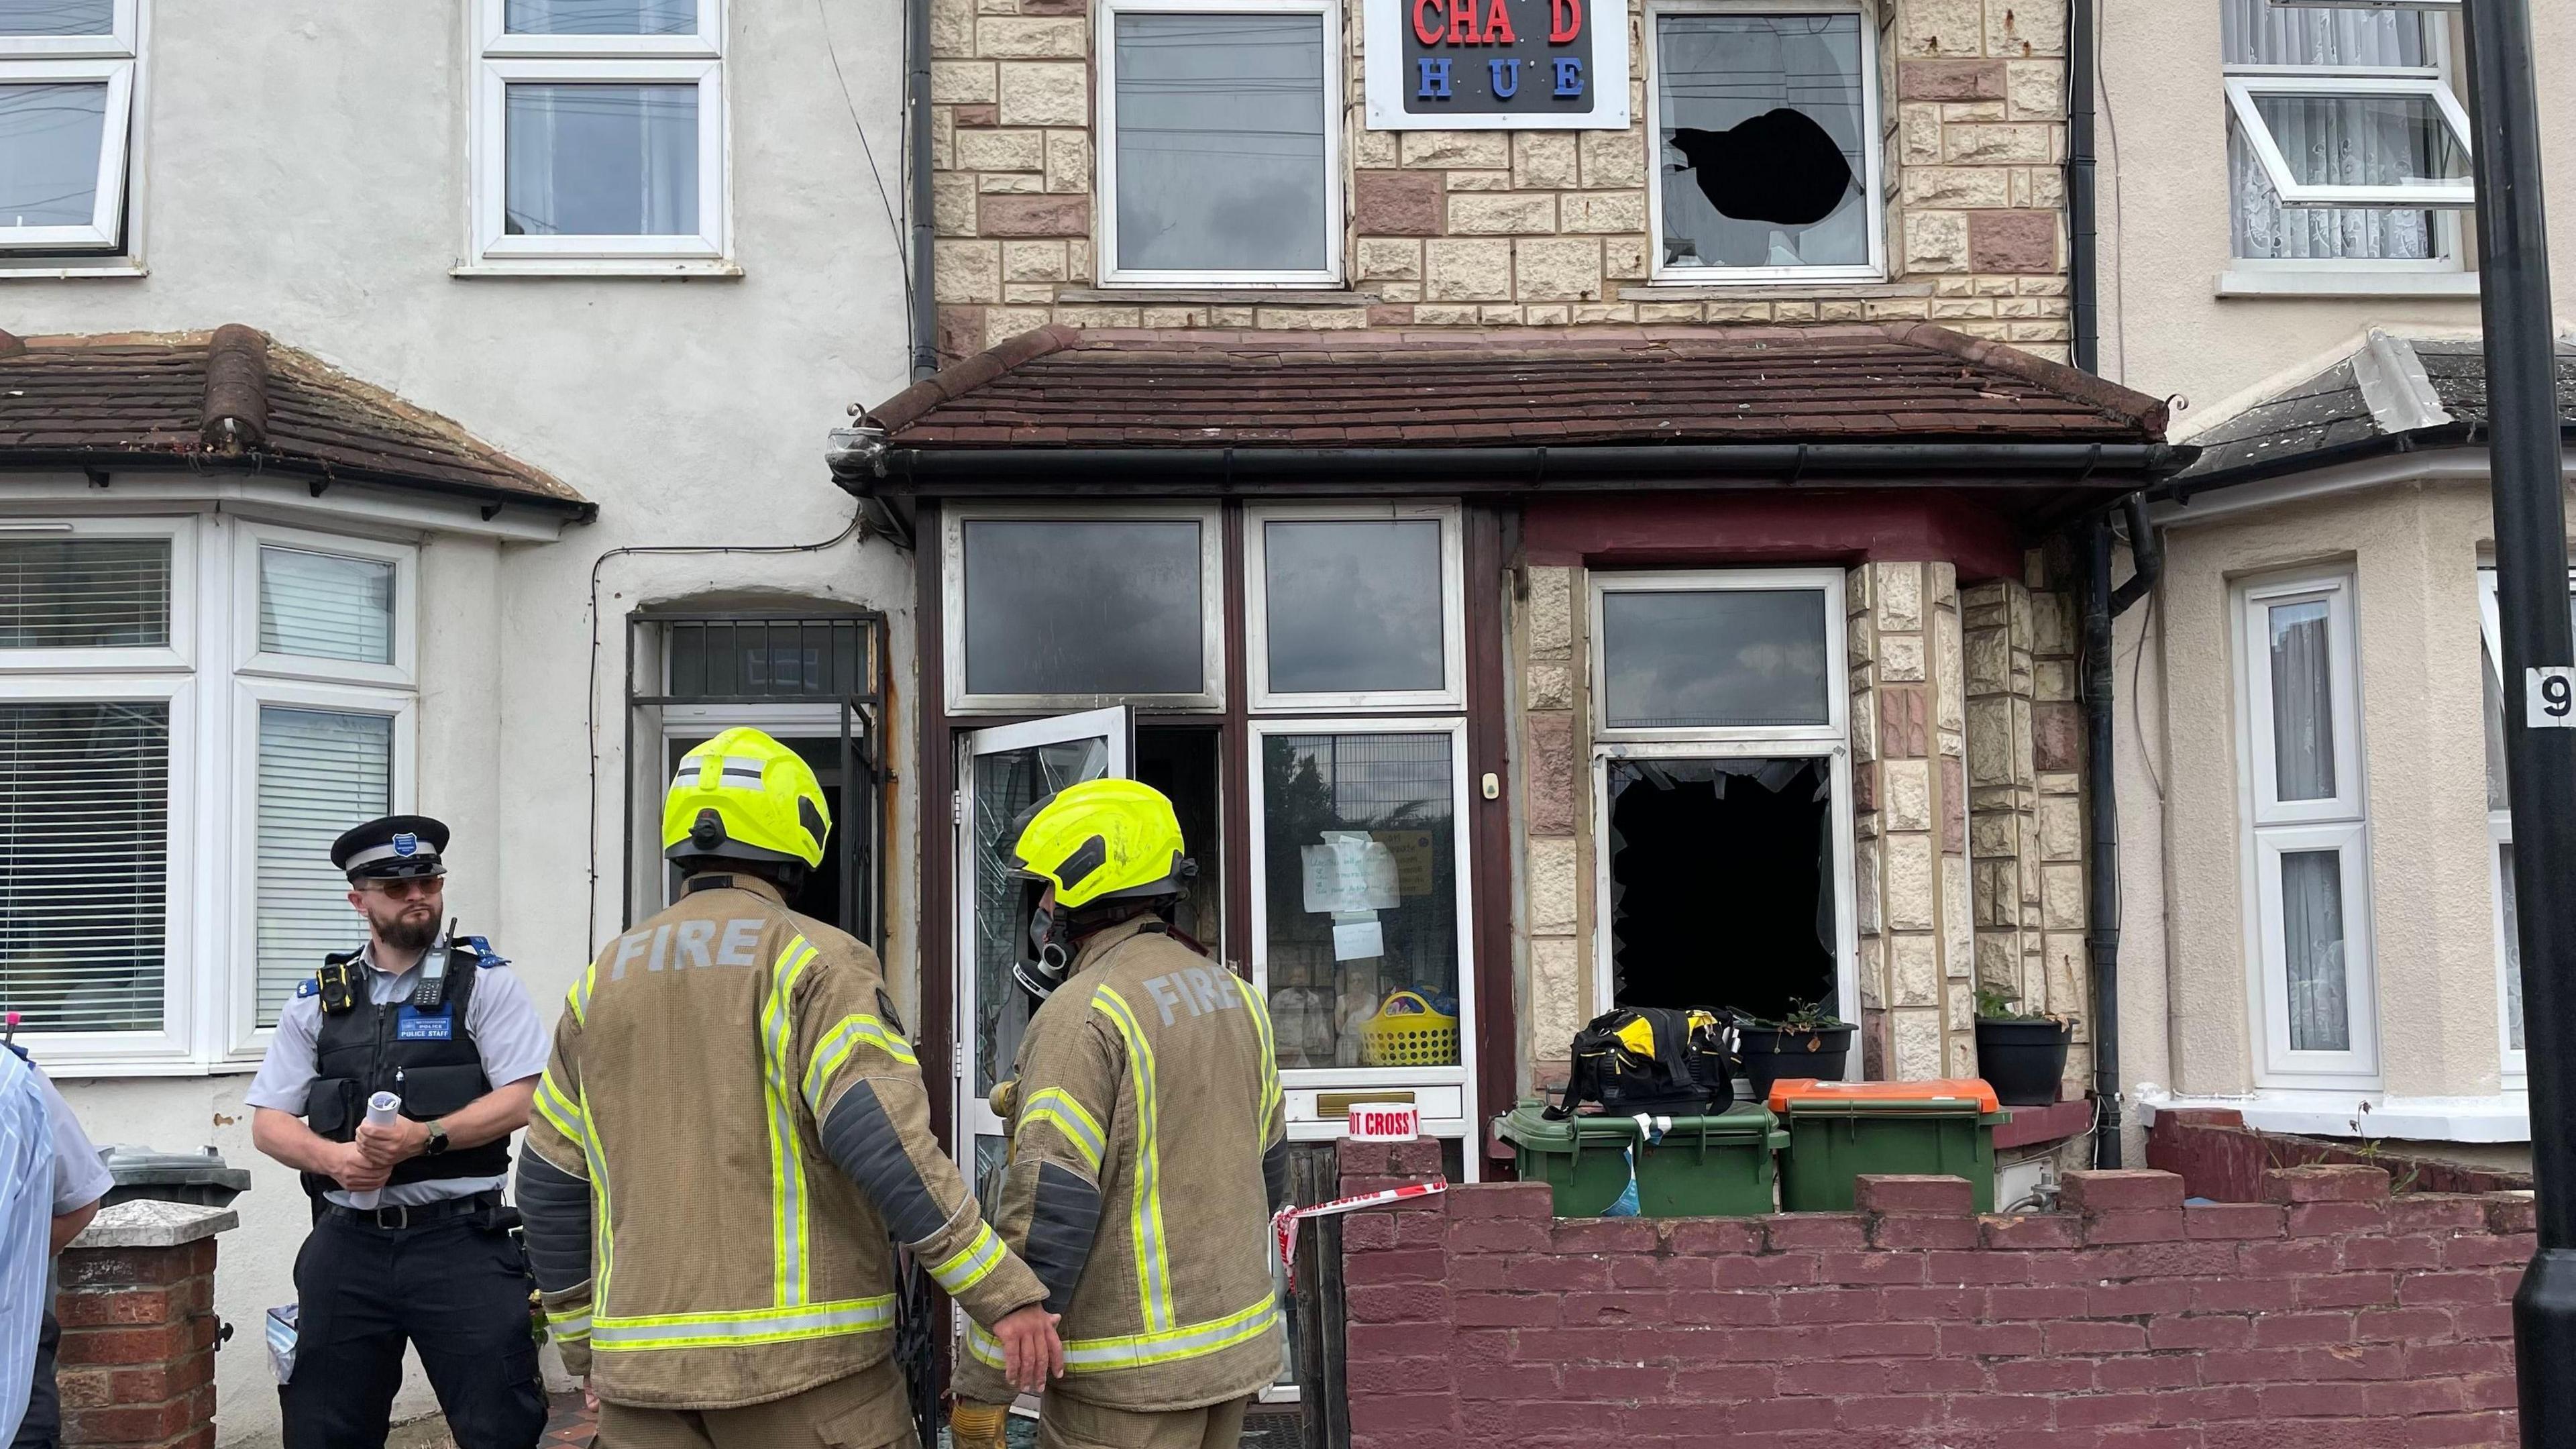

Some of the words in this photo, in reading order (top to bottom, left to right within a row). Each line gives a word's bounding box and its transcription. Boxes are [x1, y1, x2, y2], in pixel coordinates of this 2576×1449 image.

[2542, 675, 2572, 717] 9
[611, 918, 767, 982] FIRE
[1142, 966, 1242, 1028] FIRE
[1365, 1112, 1409, 1136] CROSS
